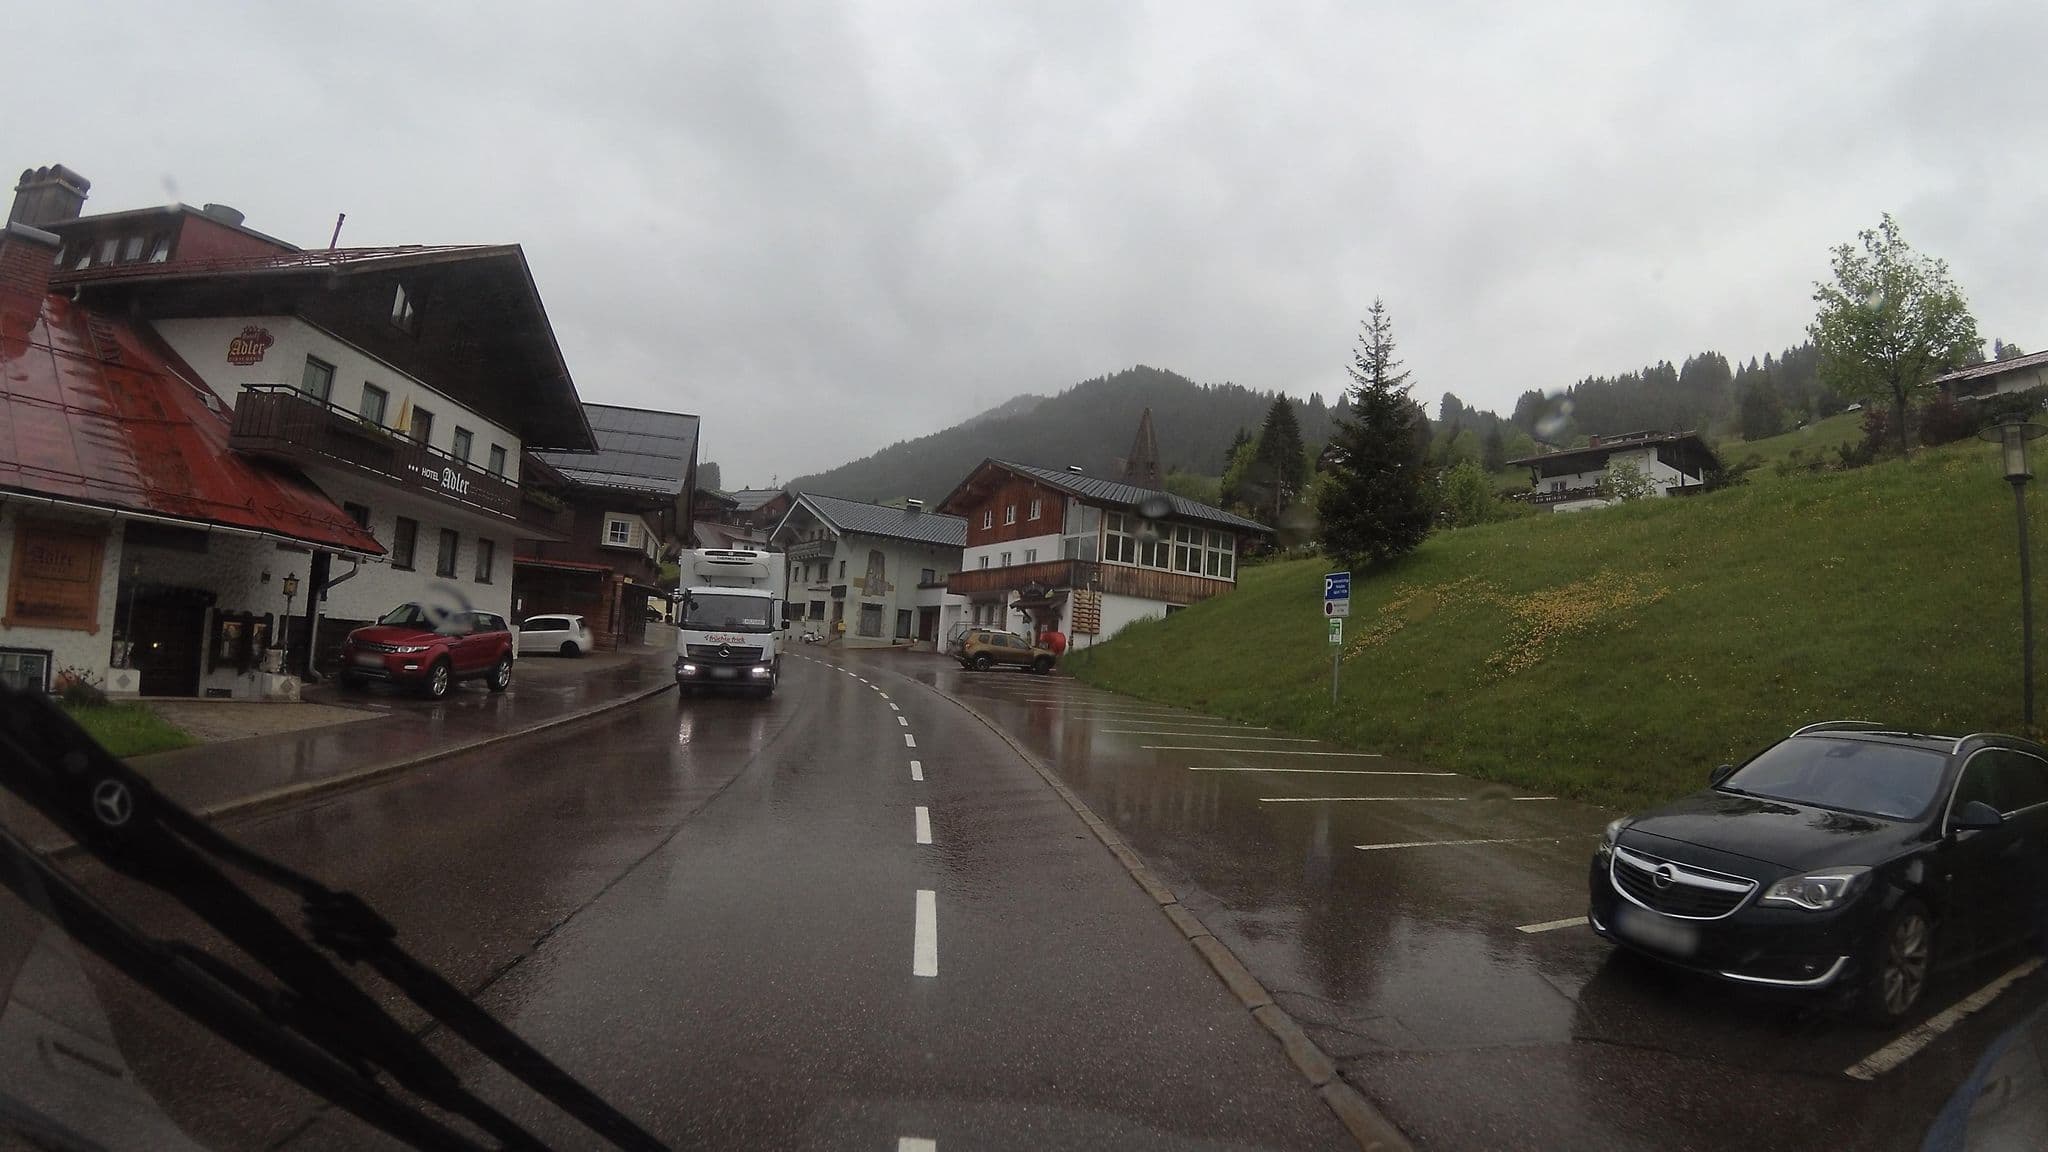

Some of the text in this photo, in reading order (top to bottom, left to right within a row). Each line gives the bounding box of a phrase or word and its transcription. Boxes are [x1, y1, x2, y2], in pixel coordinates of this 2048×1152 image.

[230, 340, 265, 355] Adler
[421, 467, 470, 495] HOTEL Adler
[1325, 579, 1333, 596] P
